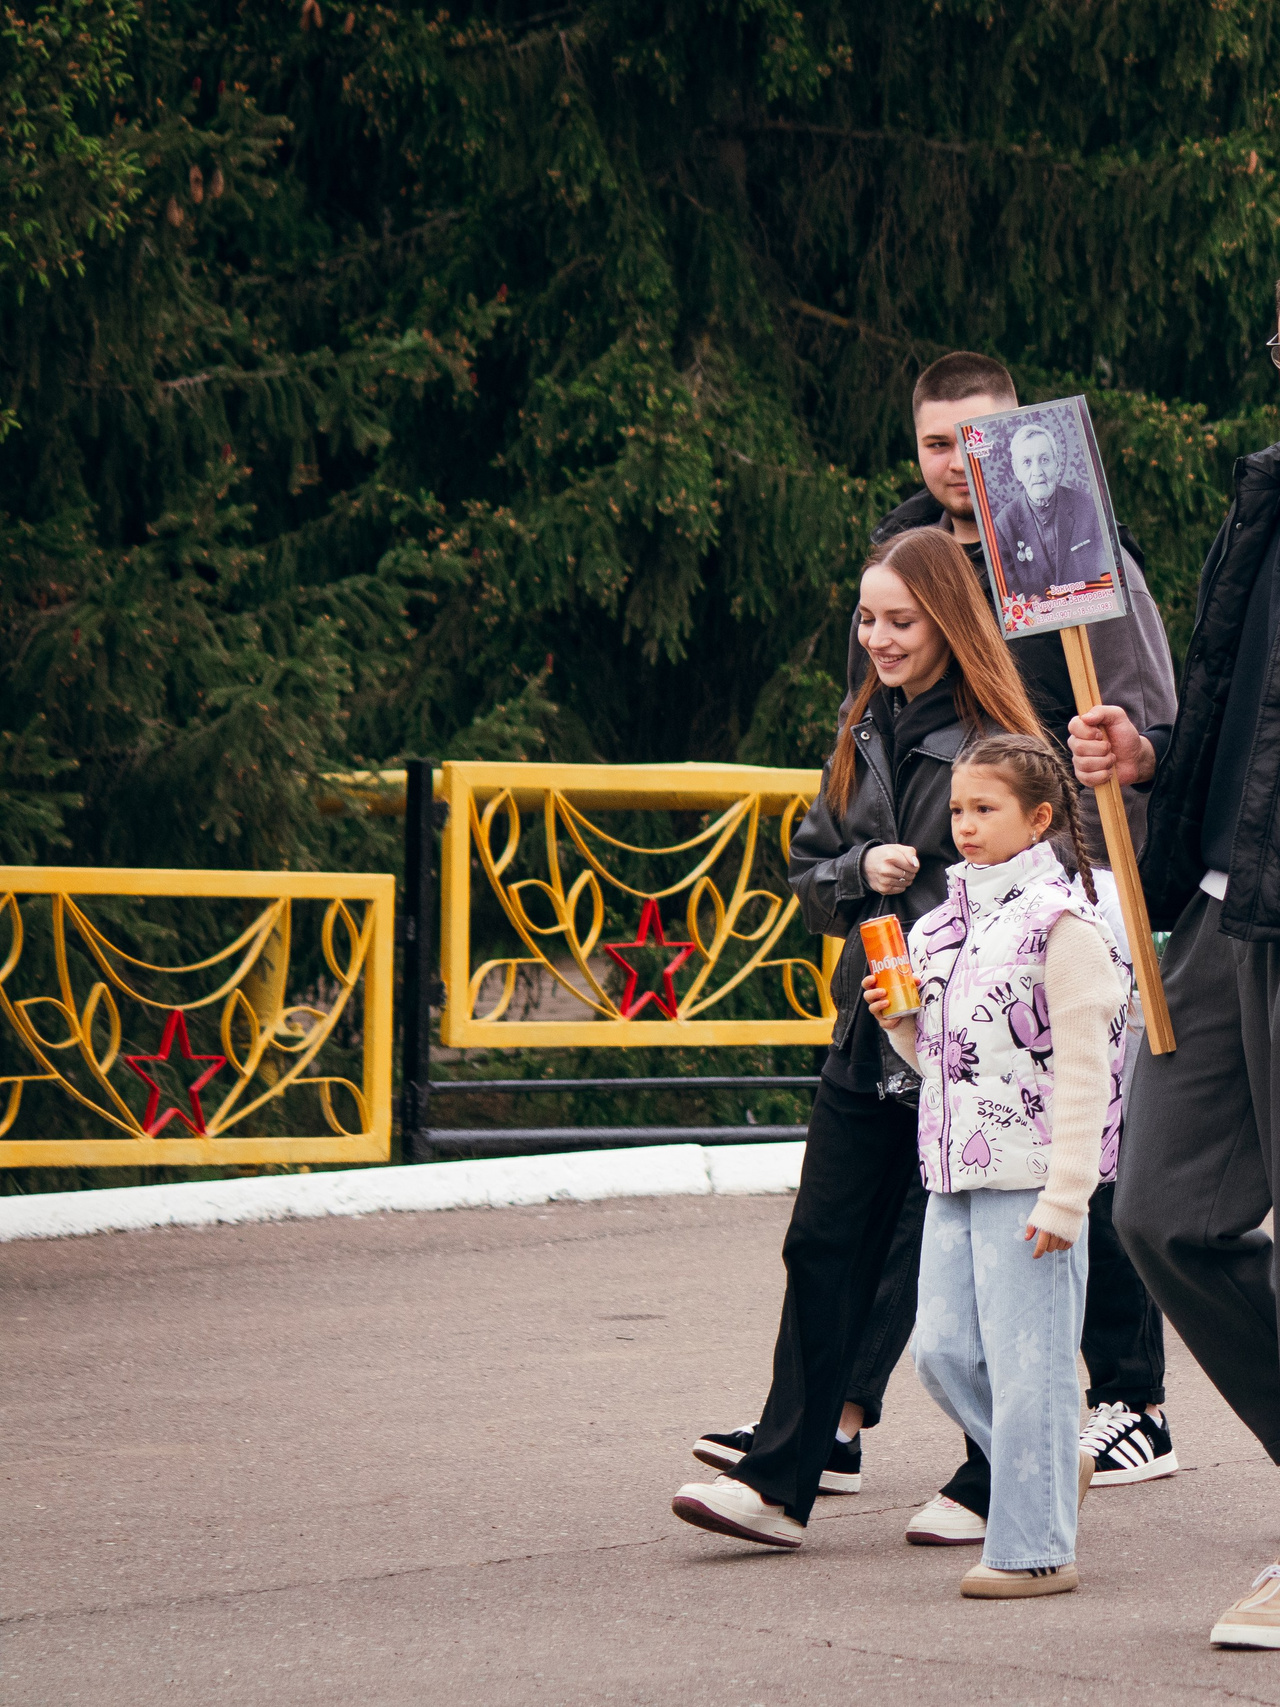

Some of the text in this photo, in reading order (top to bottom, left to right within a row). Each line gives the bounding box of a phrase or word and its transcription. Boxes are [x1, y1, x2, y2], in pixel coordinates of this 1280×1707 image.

[1050, 581, 1086, 595] Закиров
[1068, 589, 1113, 604] Закирович
[871, 951, 910, 975] Добрый
[973, 1096, 1013, 1114] more
[977, 1107, 1017, 1128] give
